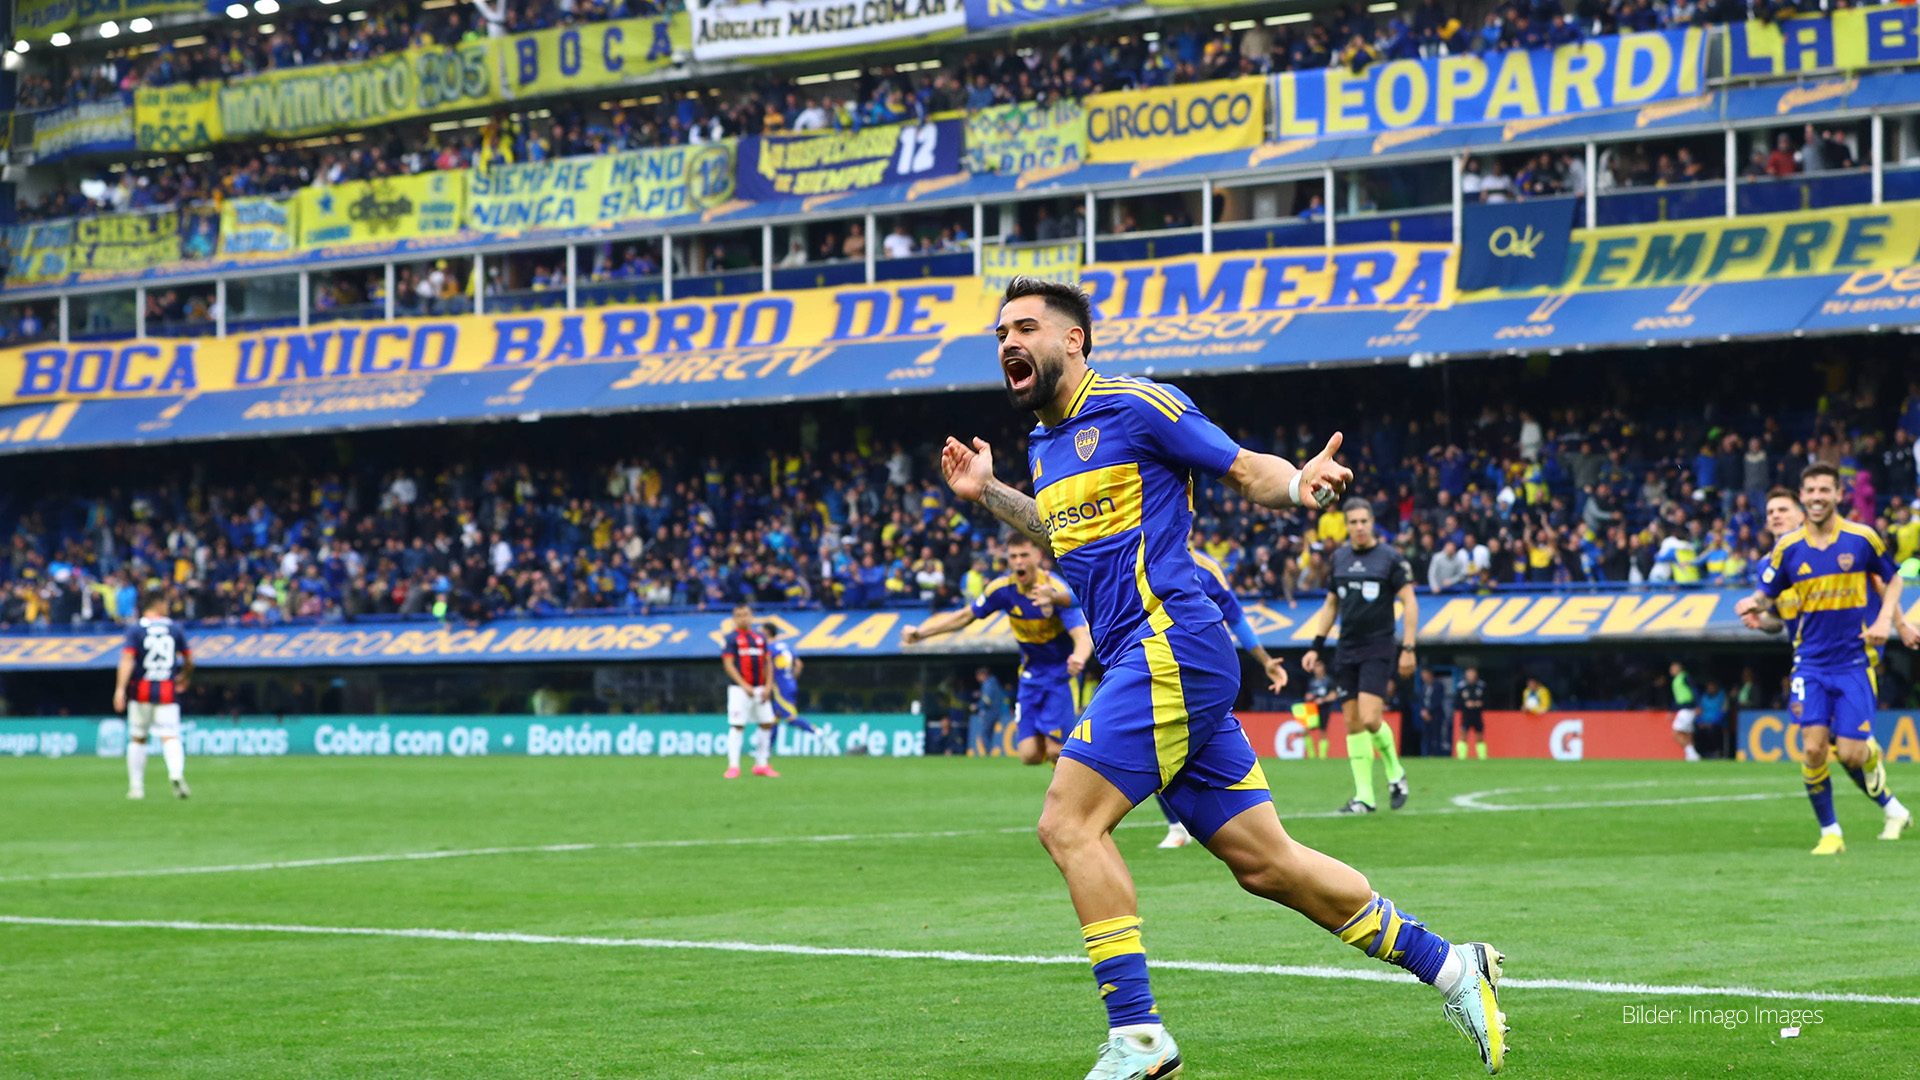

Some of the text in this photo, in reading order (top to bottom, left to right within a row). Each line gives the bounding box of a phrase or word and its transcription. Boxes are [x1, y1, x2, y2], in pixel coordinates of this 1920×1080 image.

[514, 22, 673, 86] BOCA
[1731, 17, 1834, 75] LA
[1279, 26, 1702, 137] LEOPARDI
[141, 120, 210, 150] BOCA
[1087, 92, 1252, 144] CIRCOLOCO
[896, 122, 938, 175] 12
[472, 151, 685, 196] SIEMPRE MANO
[472, 196, 576, 227] NUNCA
[600, 185, 687, 220] SAPO
[16, 249, 1449, 397] BOCA UNICO BARRIO DE RIMERA
[1091, 310, 1298, 348] etsson
[611, 342, 837, 390] DIRECTV
[1044, 496, 1117, 536] etsson
[797, 612, 900, 649] LA
[1416, 594, 1721, 638] NUEVA
[142, 634, 176, 671] 29
[382, 628, 499, 655] BOCA
[491, 623, 673, 653] JUNIORS
[1790, 676, 1806, 701] 9
[313, 722, 391, 756] Cobrá
[394, 731, 447, 756] con
[449, 728, 490, 756] QR
[527, 722, 612, 756] Botón
[615, 722, 655, 756] de
[844, 722, 889, 757] de
[1274, 720, 1307, 760] G
[1550, 719, 1584, 761] G
